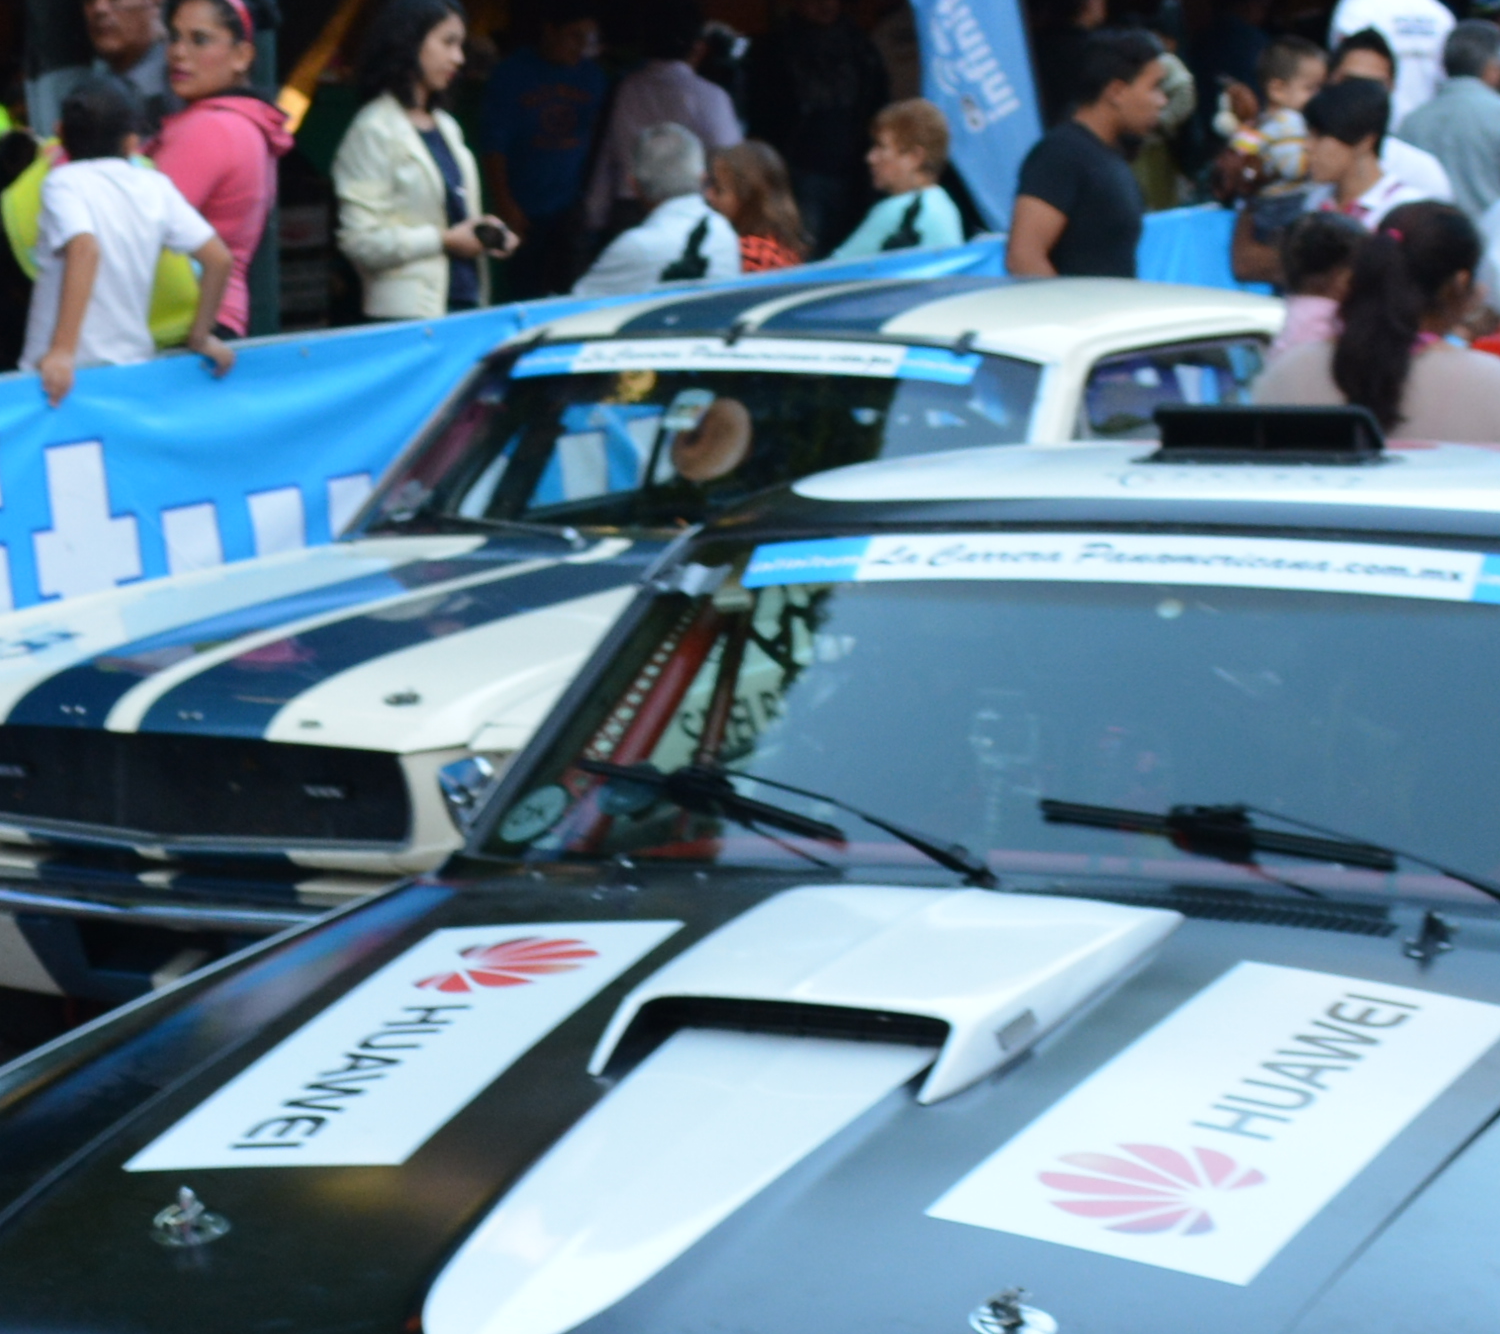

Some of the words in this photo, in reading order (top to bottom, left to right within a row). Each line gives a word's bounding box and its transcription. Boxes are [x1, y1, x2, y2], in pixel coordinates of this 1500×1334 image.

[869, 543, 919, 567] La
[926, 541, 1063, 568] Carrera
[230, 1002, 474, 1151] HUAWEI
[1192, 991, 1423, 1143] HUAWEI
